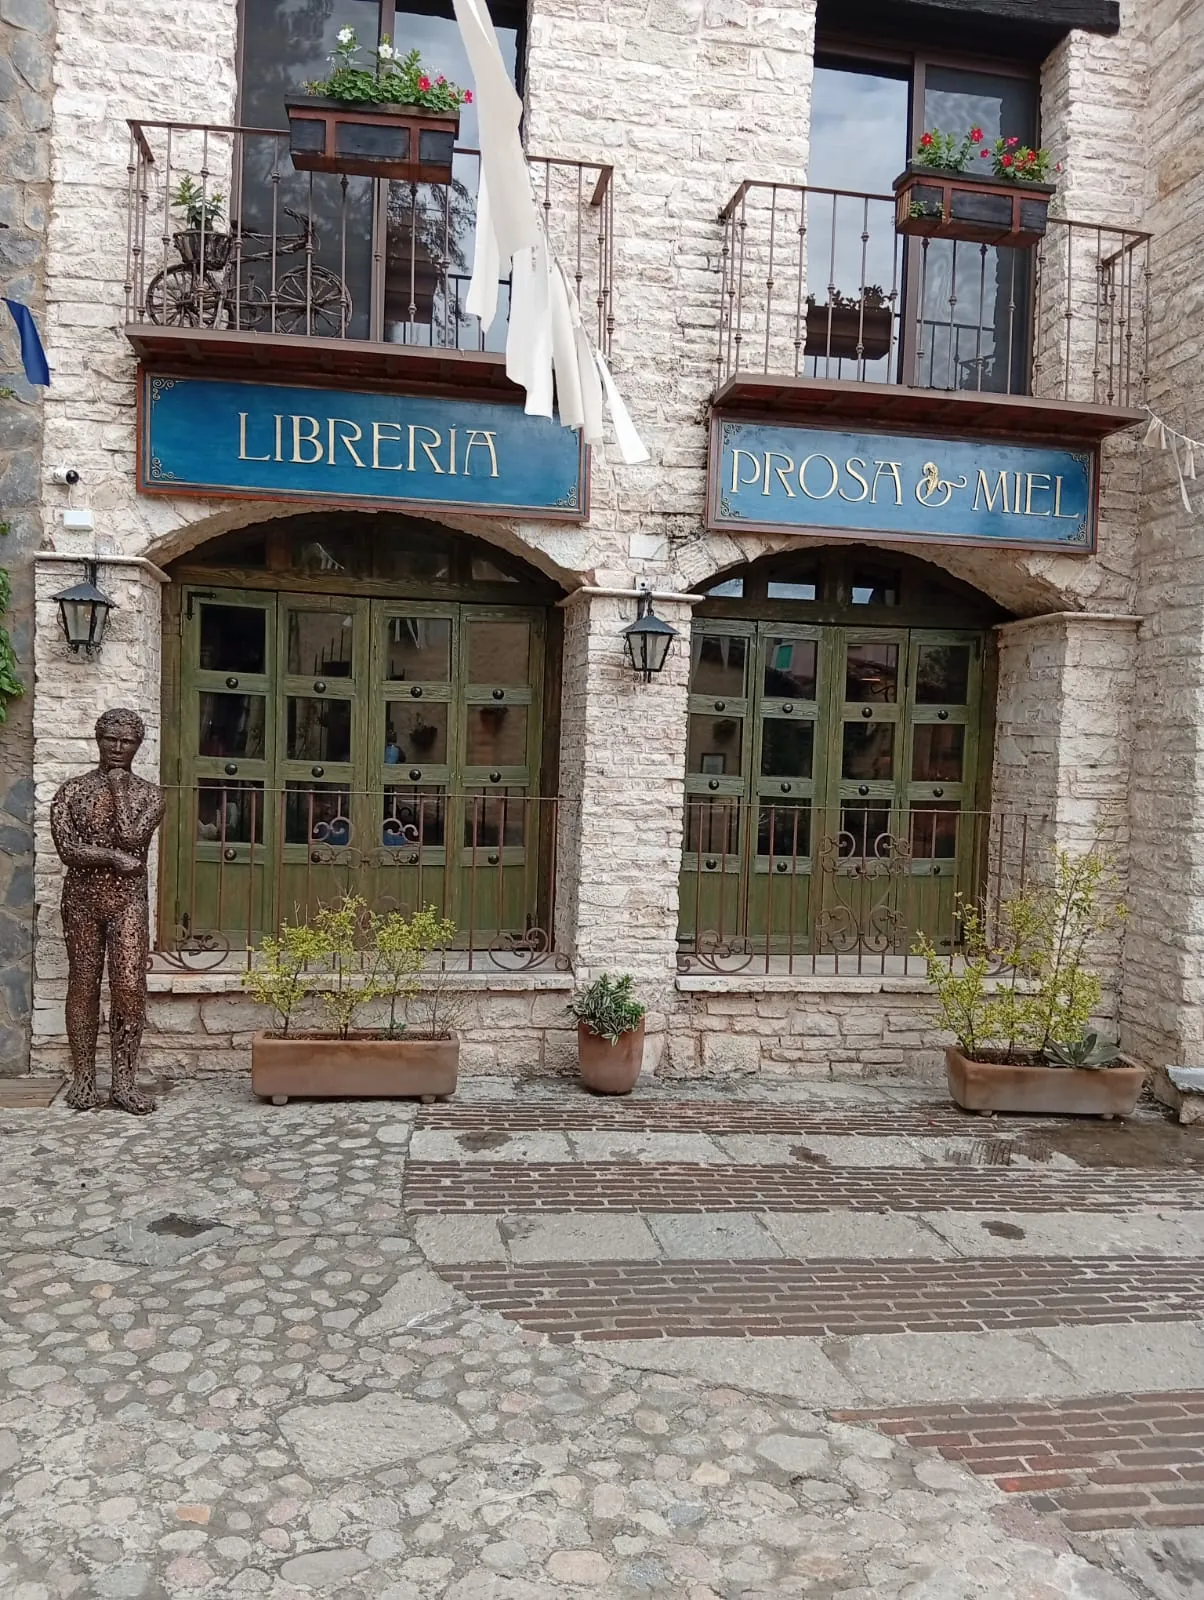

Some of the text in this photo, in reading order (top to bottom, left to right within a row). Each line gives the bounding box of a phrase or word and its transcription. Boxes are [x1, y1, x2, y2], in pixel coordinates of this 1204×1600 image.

[238, 412, 499, 477] LIBRERÍA
[730, 449, 1080, 519] PROSA & MIEL
